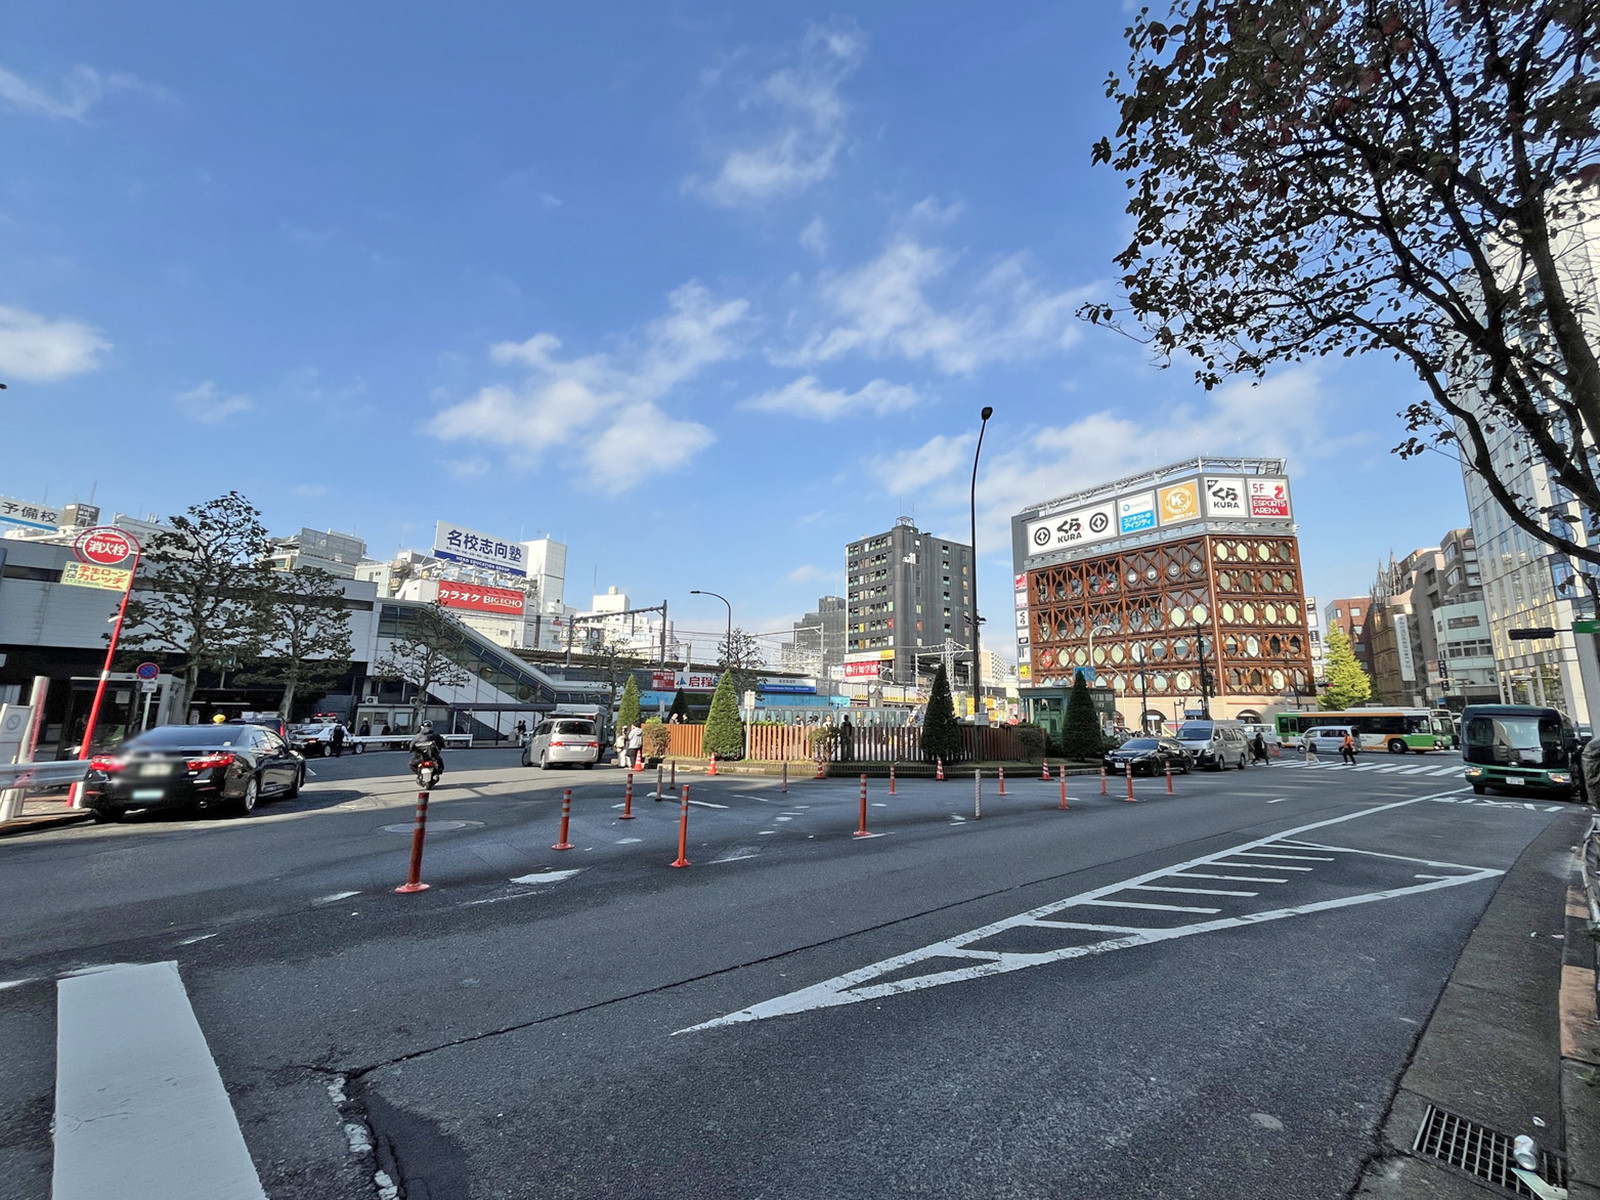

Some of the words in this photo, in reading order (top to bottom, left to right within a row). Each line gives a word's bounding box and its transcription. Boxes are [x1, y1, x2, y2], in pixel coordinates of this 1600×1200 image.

[1212, 487, 1239, 501] くら
[1252, 483, 1265, 494] 5F
[1213, 501, 1240, 509] KURA
[1253, 500, 1287, 508] ESPORTS
[1, 501, 58, 524] 予備校
[1056, 517, 1081, 534] くら
[1057, 532, 1082, 544] KURA
[87, 540, 127, 556] 消火栓
[446, 529, 522, 562] 名校志向塾
[80, 565, 129, 578] 学生ローン
[439, 589, 481, 602] カラオケ
[483, 596, 500, 604] BIG
[500, 598, 523, 608] ECHO
